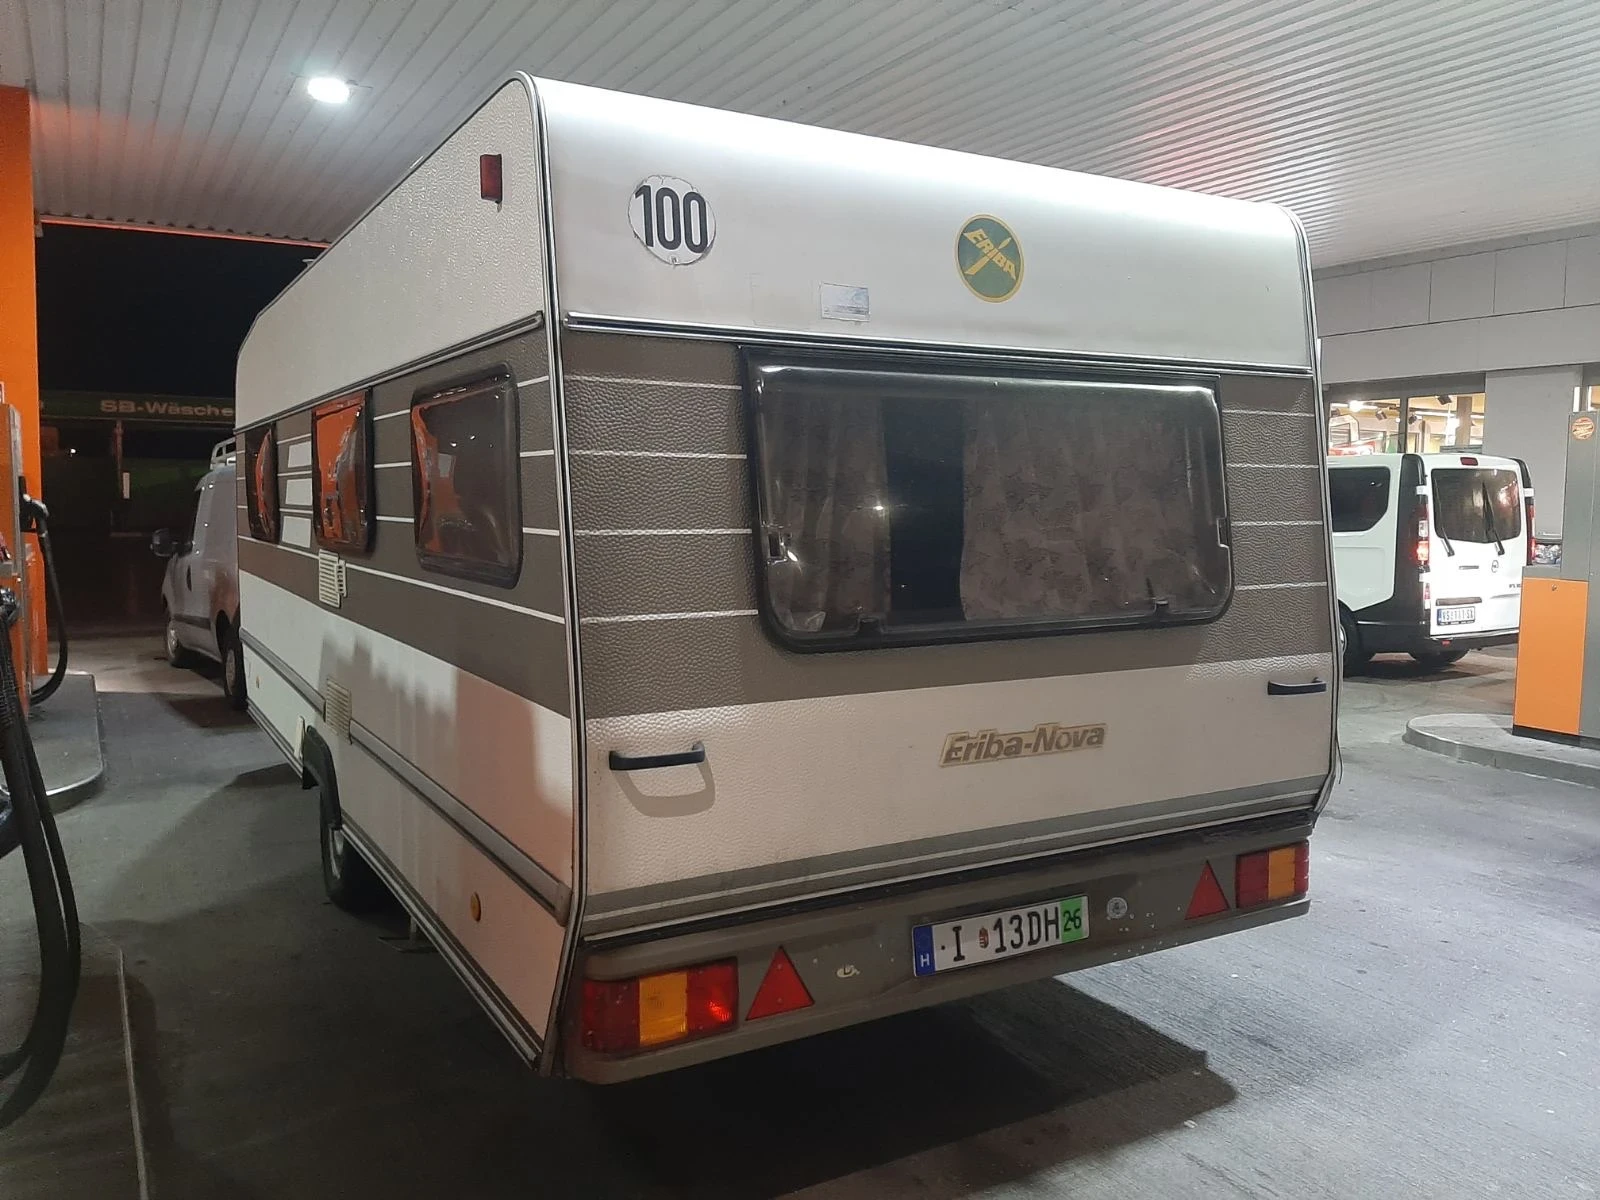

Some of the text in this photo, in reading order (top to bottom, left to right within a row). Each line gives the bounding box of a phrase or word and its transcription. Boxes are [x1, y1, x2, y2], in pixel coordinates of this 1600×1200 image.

[635, 184, 708, 253] 100
[962, 228, 1018, 281] ERIBA
[100, 399, 234, 417] SB-Wäsche
[942, 727, 1105, 764] Eriba-Nova
[920, 953, 930, 968] H
